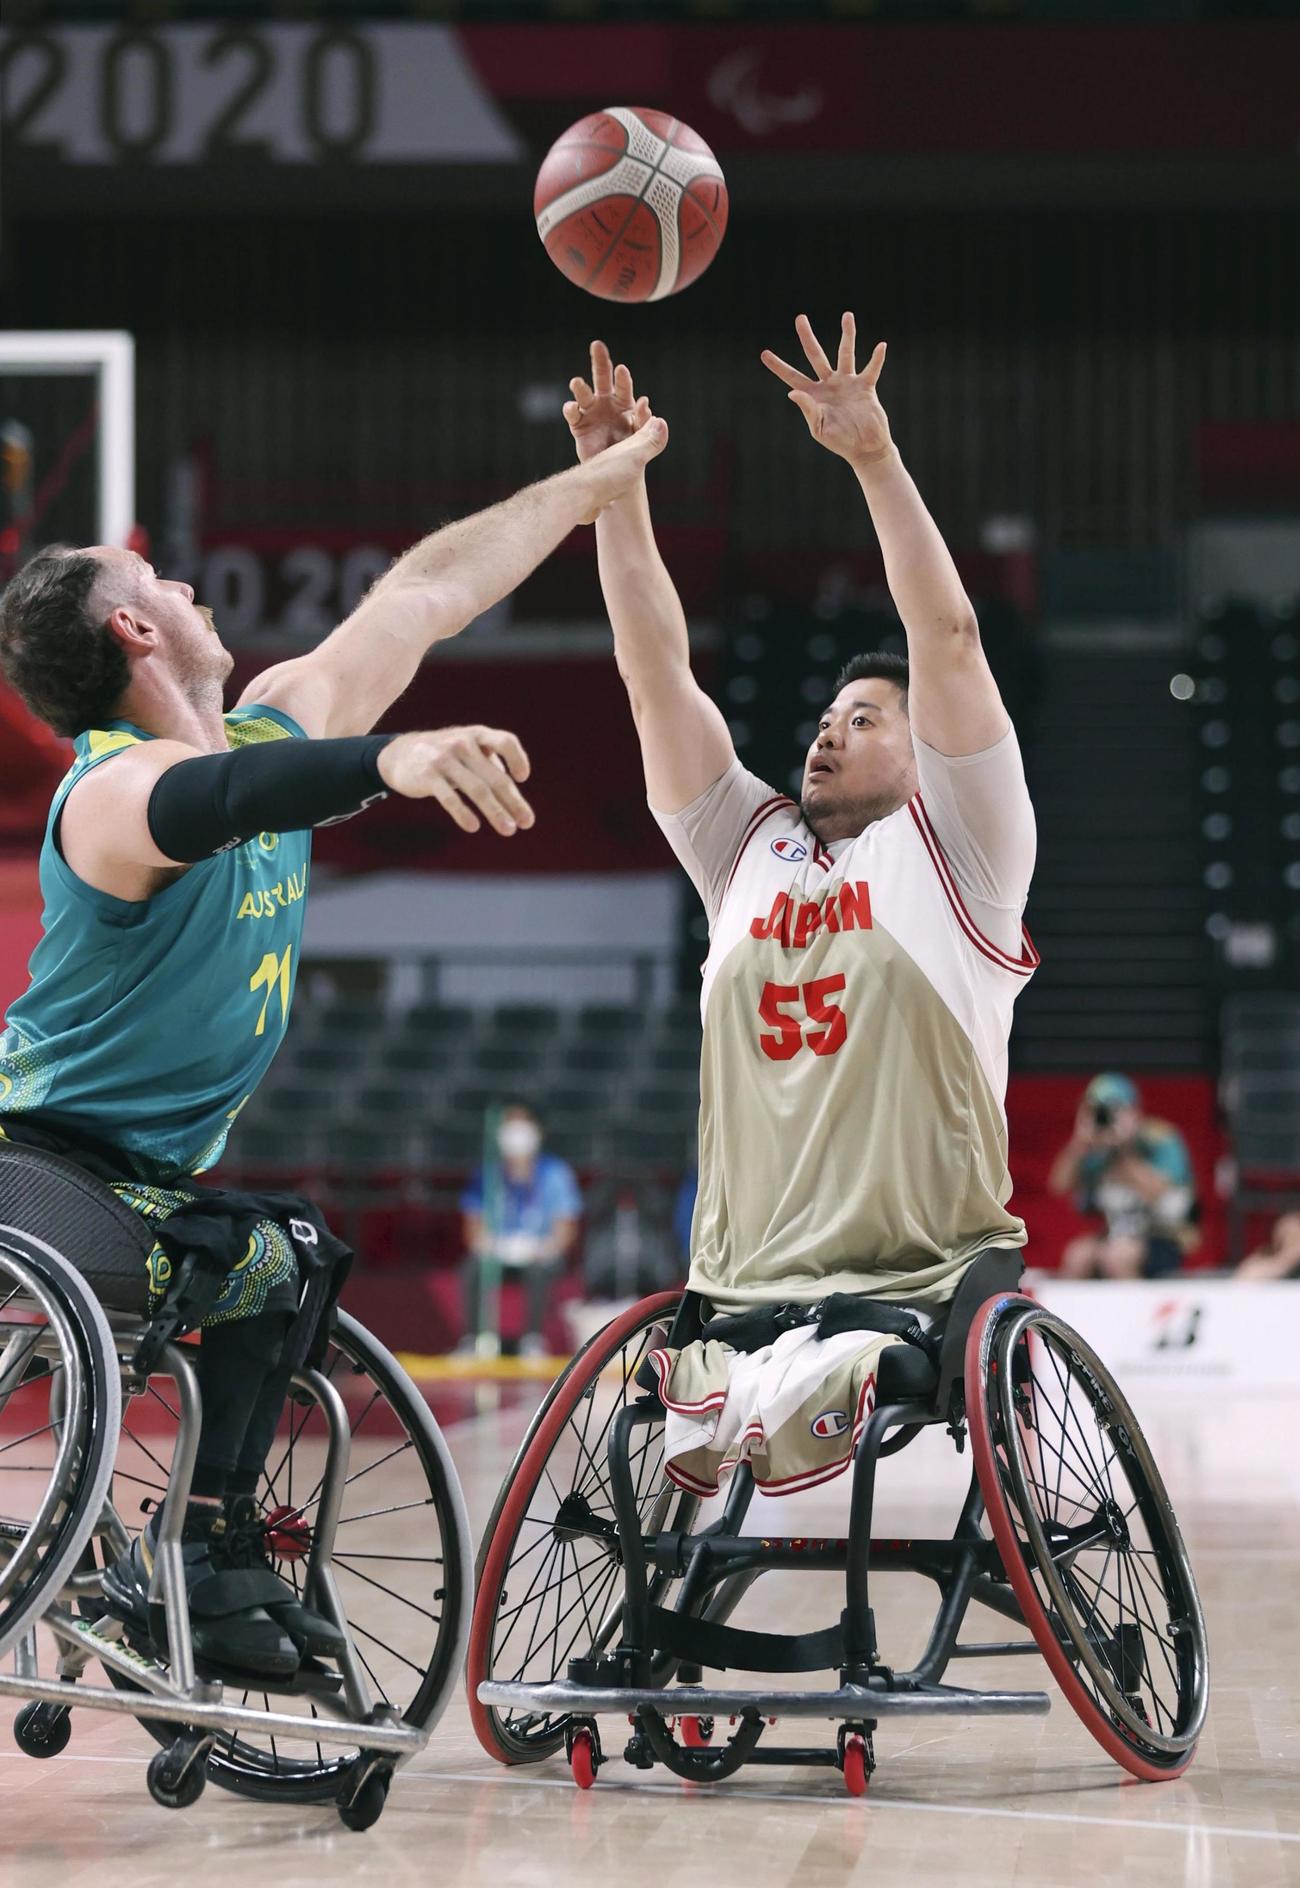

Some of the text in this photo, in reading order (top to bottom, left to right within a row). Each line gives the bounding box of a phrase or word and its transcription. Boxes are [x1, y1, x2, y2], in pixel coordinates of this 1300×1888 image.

[0, 27, 377, 162] 2020
[749, 880, 873, 949] JAPAN
[758, 972, 848, 1061] 55
[1069, 1350, 1138, 1459] SPINEGY
